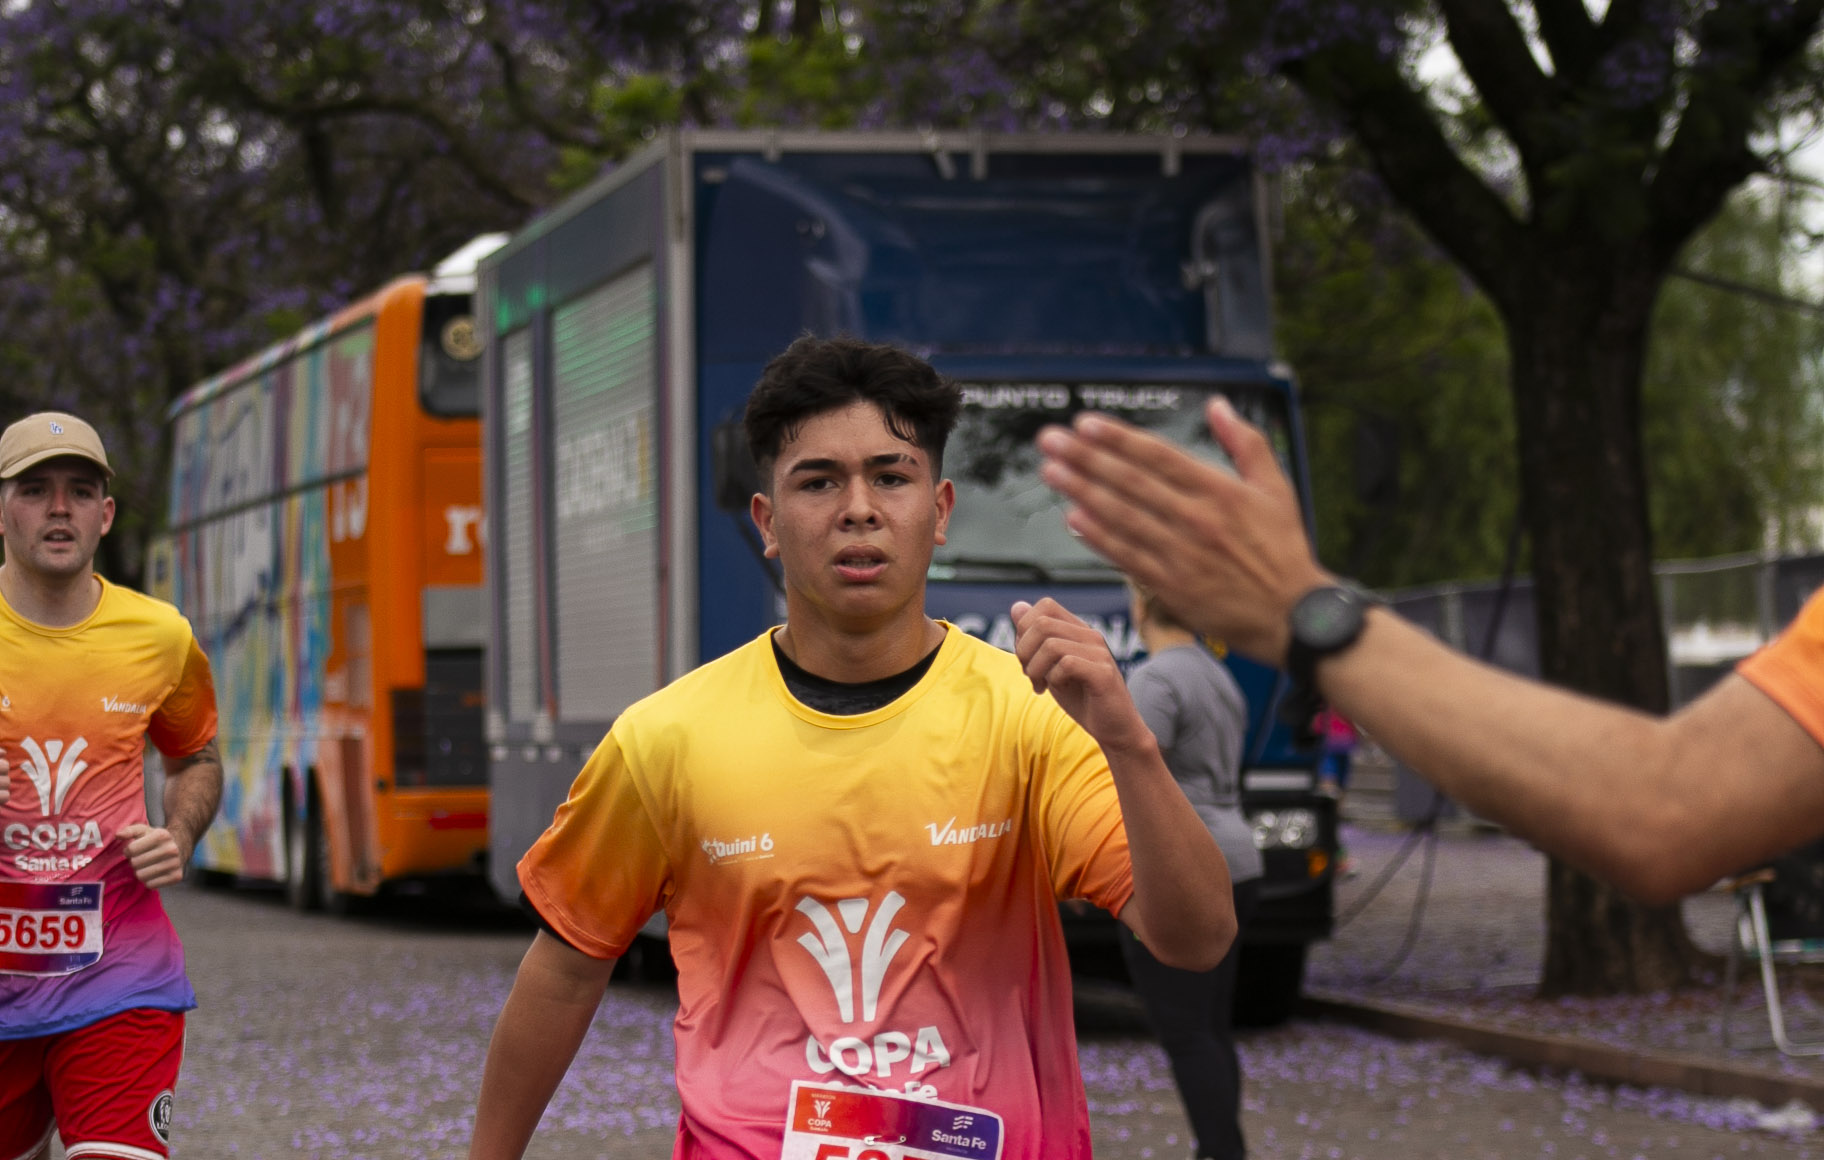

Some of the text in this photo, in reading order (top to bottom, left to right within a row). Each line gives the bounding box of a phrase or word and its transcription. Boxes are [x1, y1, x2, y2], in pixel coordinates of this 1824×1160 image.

[1077, 384, 1181, 410] TRUCK
[4, 820, 104, 851] COPA
[715, 832, 774, 857] Quini 6
[14, 854, 70, 872] Santa
[808, 1118, 832, 1128] COPA
[931, 1129, 970, 1147] Santa
[971, 1136, 987, 1150] Fe
